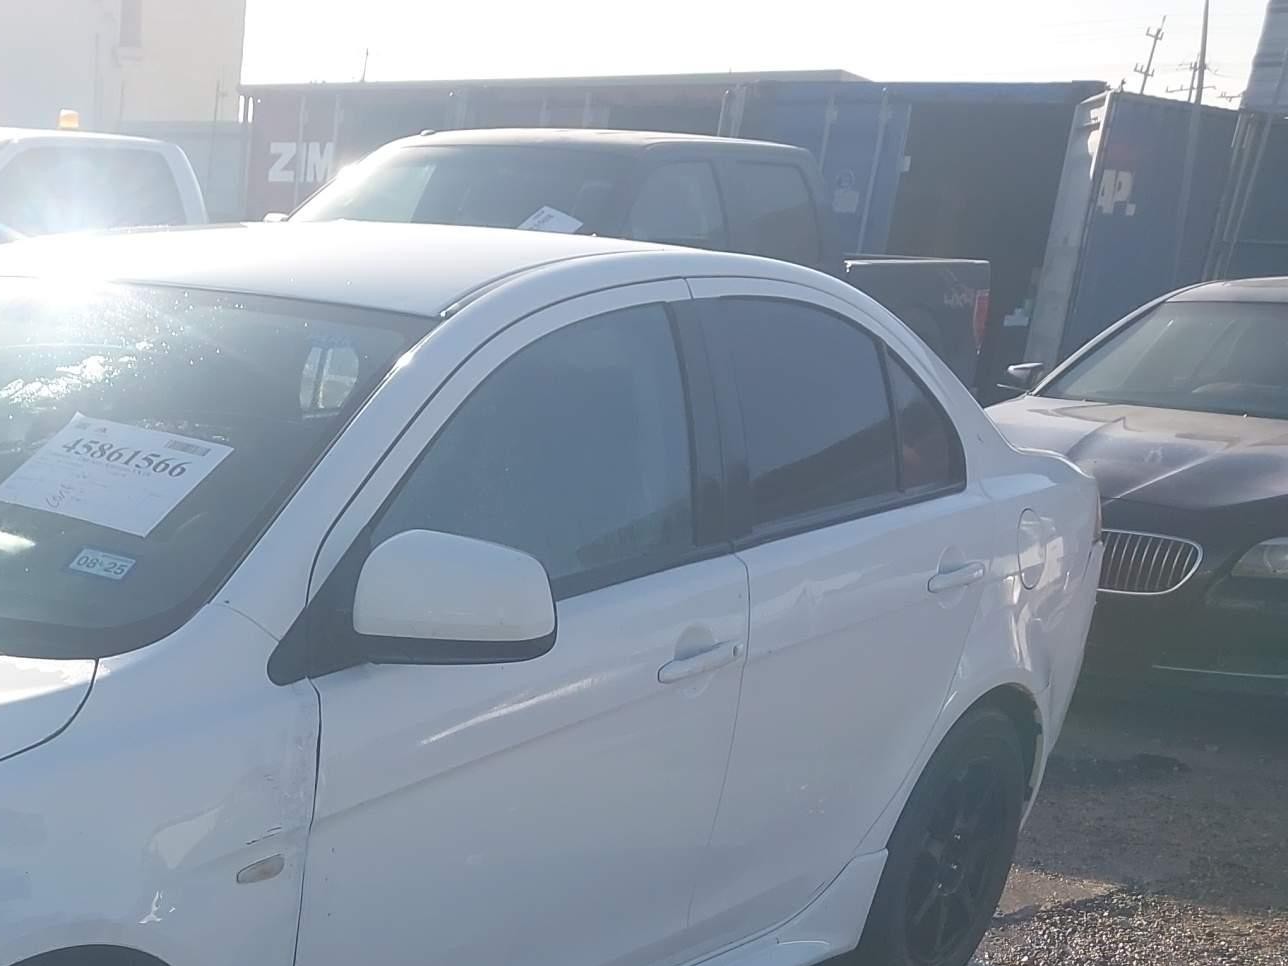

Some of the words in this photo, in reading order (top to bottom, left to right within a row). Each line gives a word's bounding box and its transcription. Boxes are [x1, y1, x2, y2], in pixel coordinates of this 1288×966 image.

[268, 141, 336, 183] ZIM
[61, 437, 192, 478] 45861566
[76, 555, 99, 569] 08
[103, 561, 129, 575] 25
